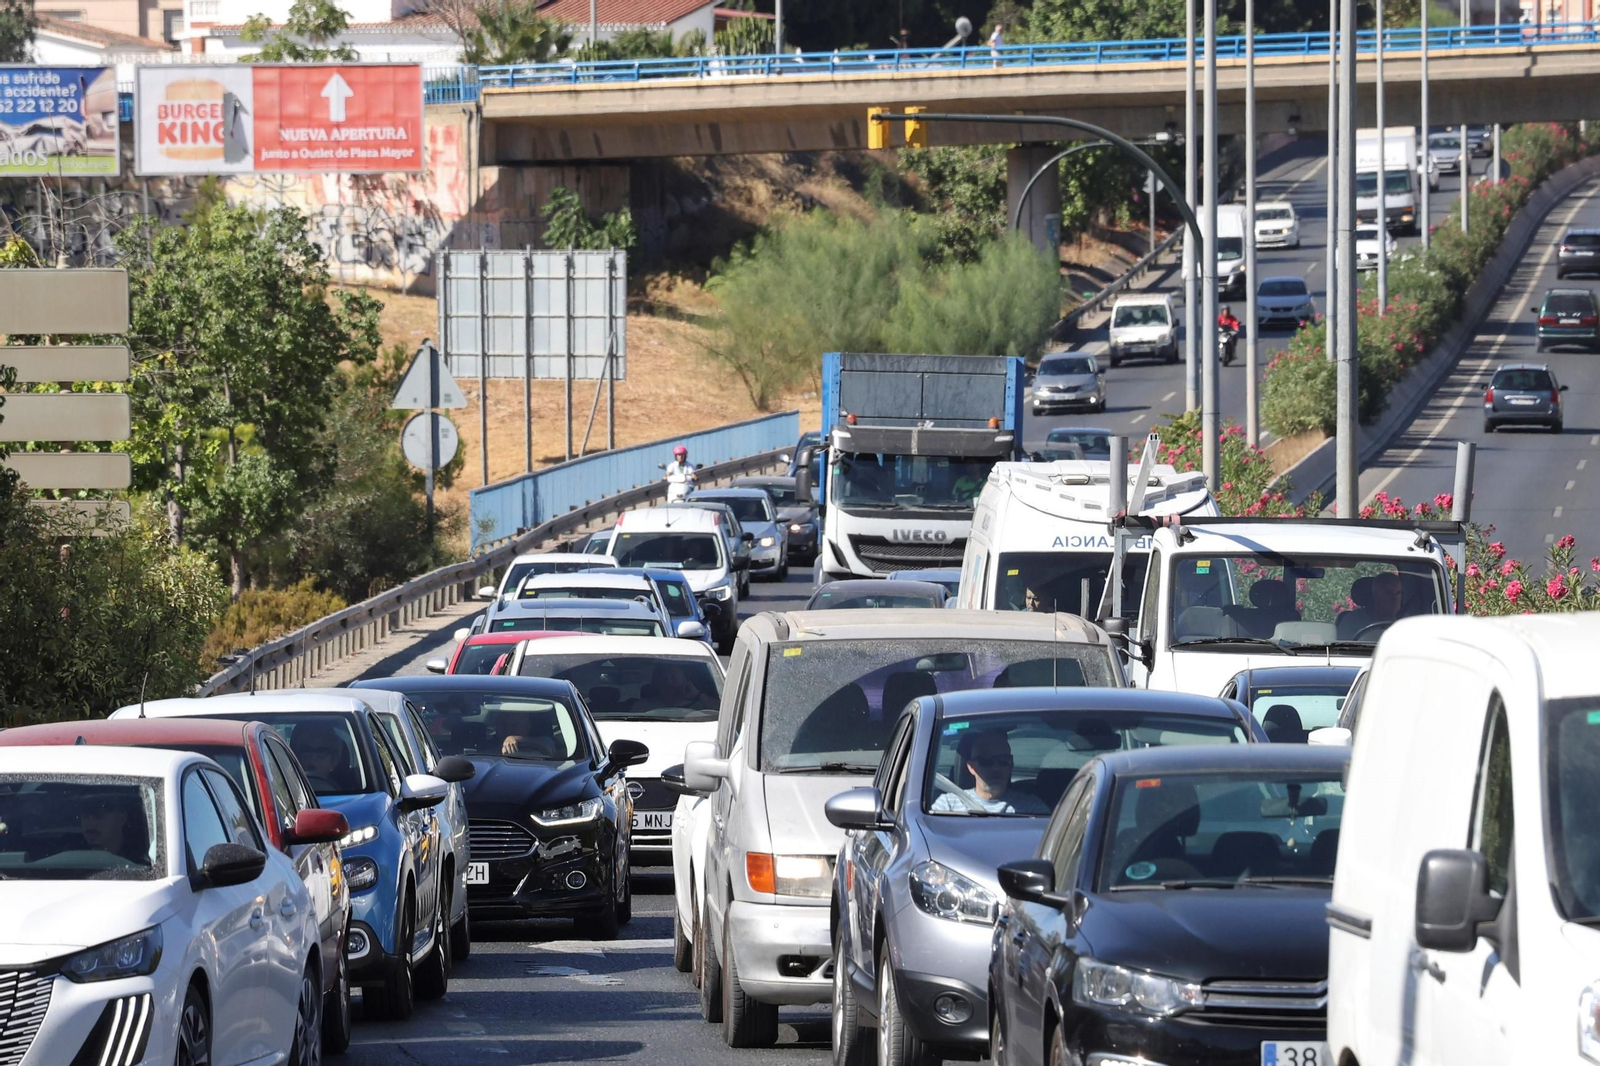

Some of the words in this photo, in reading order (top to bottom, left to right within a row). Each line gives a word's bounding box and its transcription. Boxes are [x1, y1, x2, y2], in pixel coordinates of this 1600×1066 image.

[12, 70, 60, 84] sufrido
[5, 84, 77, 97] accidente?
[17, 99, 36, 113] 22
[39, 99, 55, 113] 12
[58, 99, 78, 113] 20
[280, 128, 328, 141] NUEVA
[331, 127, 407, 141] APERTURA
[261, 147, 290, 161] junto
[291, 149, 299, 159] a
[300, 147, 334, 159] Outlet
[335, 147, 349, 158] de
[350, 147, 379, 158] Plaza
[380, 146, 414, 160] Mayor
[893, 529, 947, 541] IVECO
[644, 814, 673, 827] MNJ
[1284, 1047, 1317, 1066] 38
